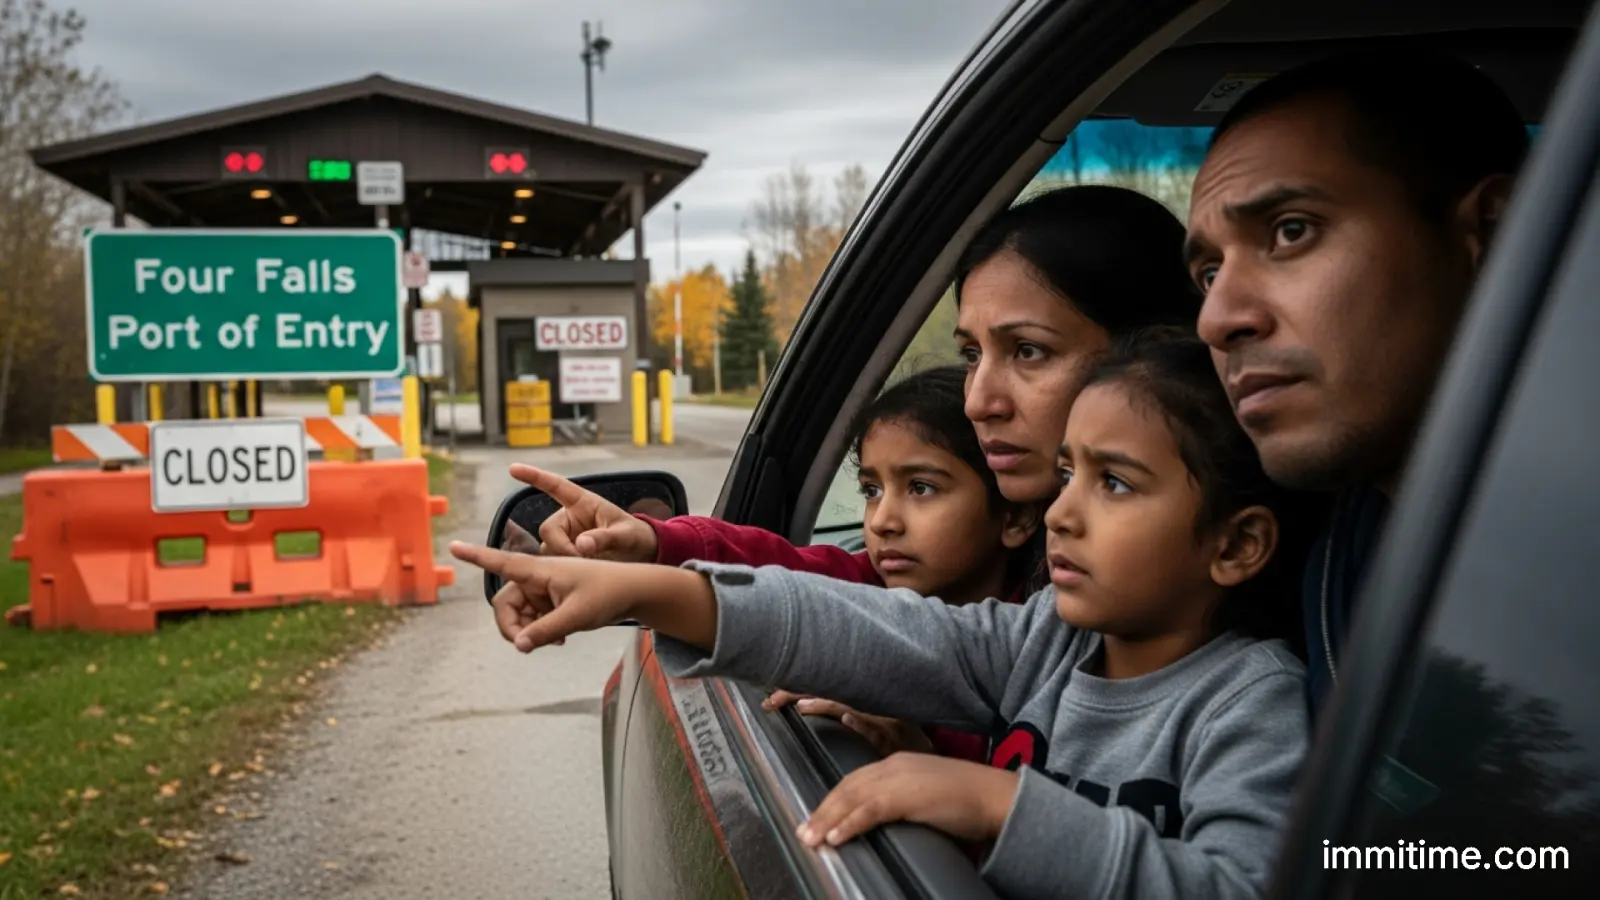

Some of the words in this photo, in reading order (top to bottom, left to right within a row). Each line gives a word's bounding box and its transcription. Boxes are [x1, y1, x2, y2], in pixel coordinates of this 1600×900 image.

[135, 258, 234, 294] Four
[256, 258, 356, 294] Falls
[108, 314, 202, 350] Port
[217, 313, 260, 350] of
[276, 312, 389, 356] Entry
[540, 321, 624, 345] CLOSED
[163, 446, 296, 486] CLOSED
